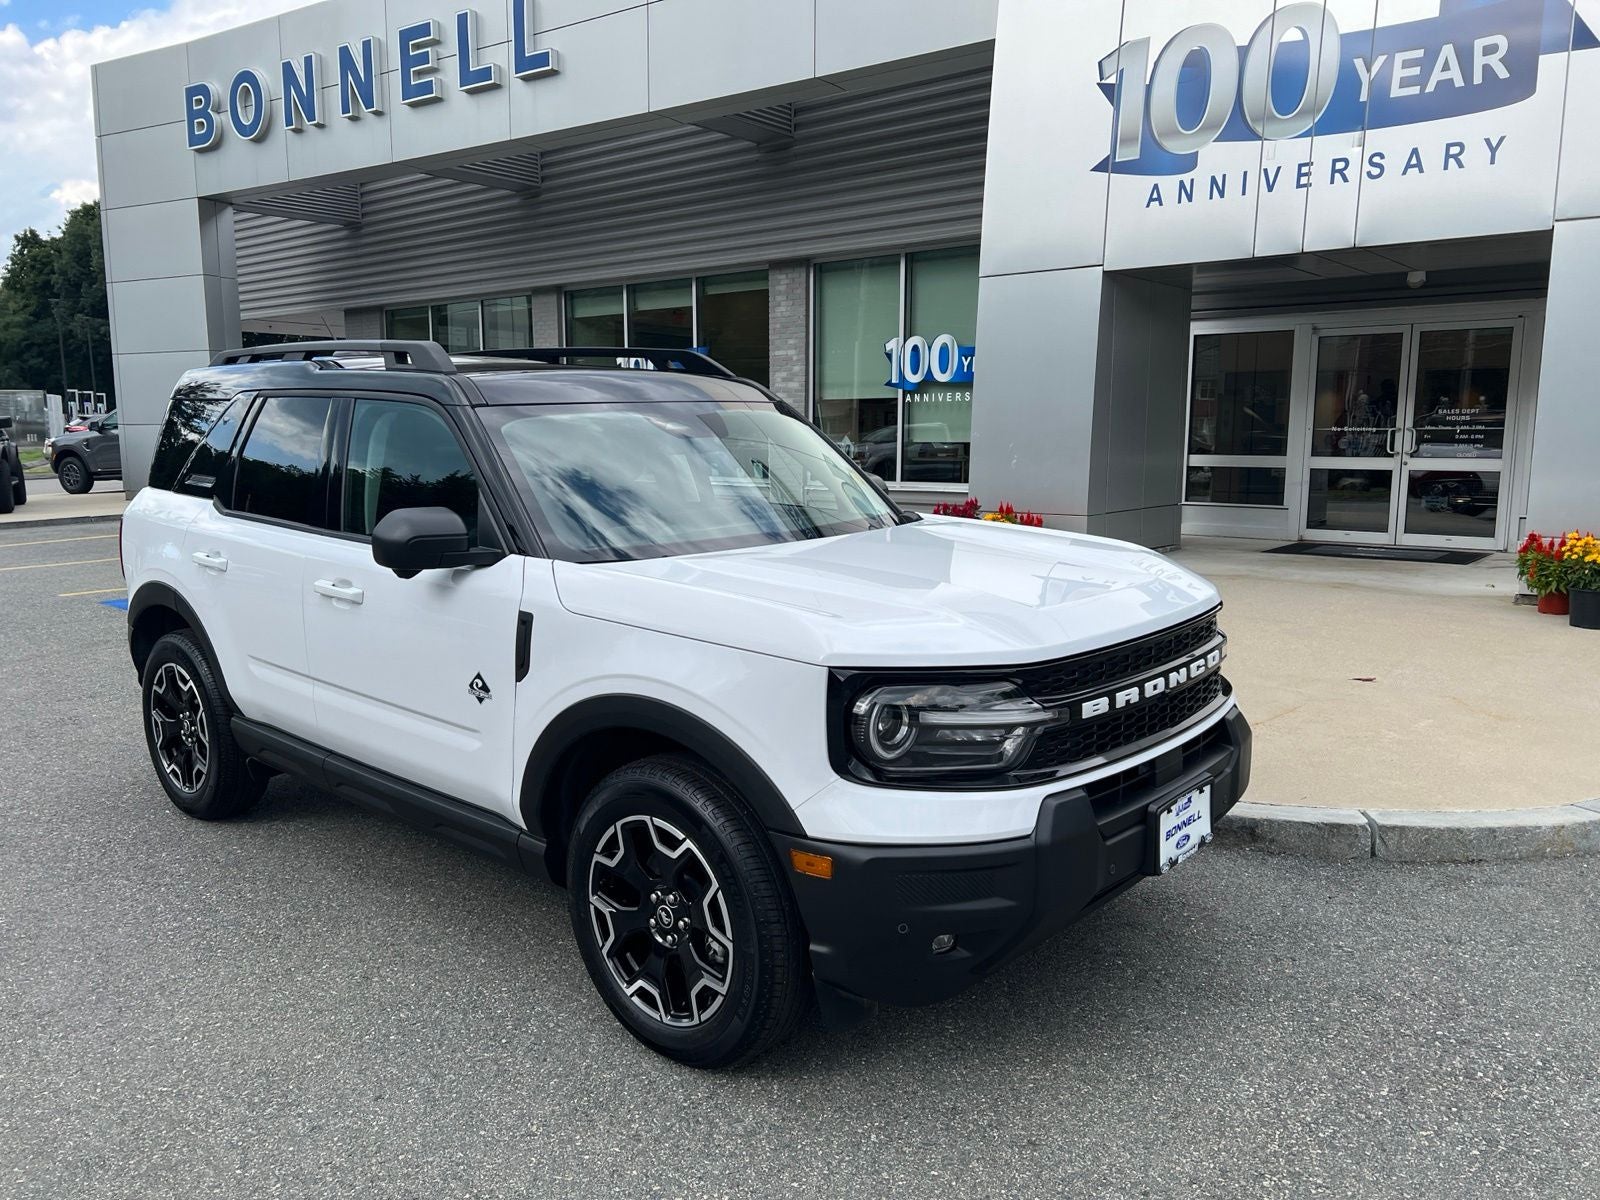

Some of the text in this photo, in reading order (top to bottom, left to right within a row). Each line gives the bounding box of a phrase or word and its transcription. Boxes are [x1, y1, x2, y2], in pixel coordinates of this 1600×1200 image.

[184, 0, 560, 152] BONNELL
[1098, 2, 1511, 163] 100 YEAR
[1145, 135, 1507, 209] ANNIVERSARY
[885, 333, 976, 384] 100 Y
[1081, 649, 1220, 719] BRONCO
[1165, 810, 1202, 842] BONNELL
